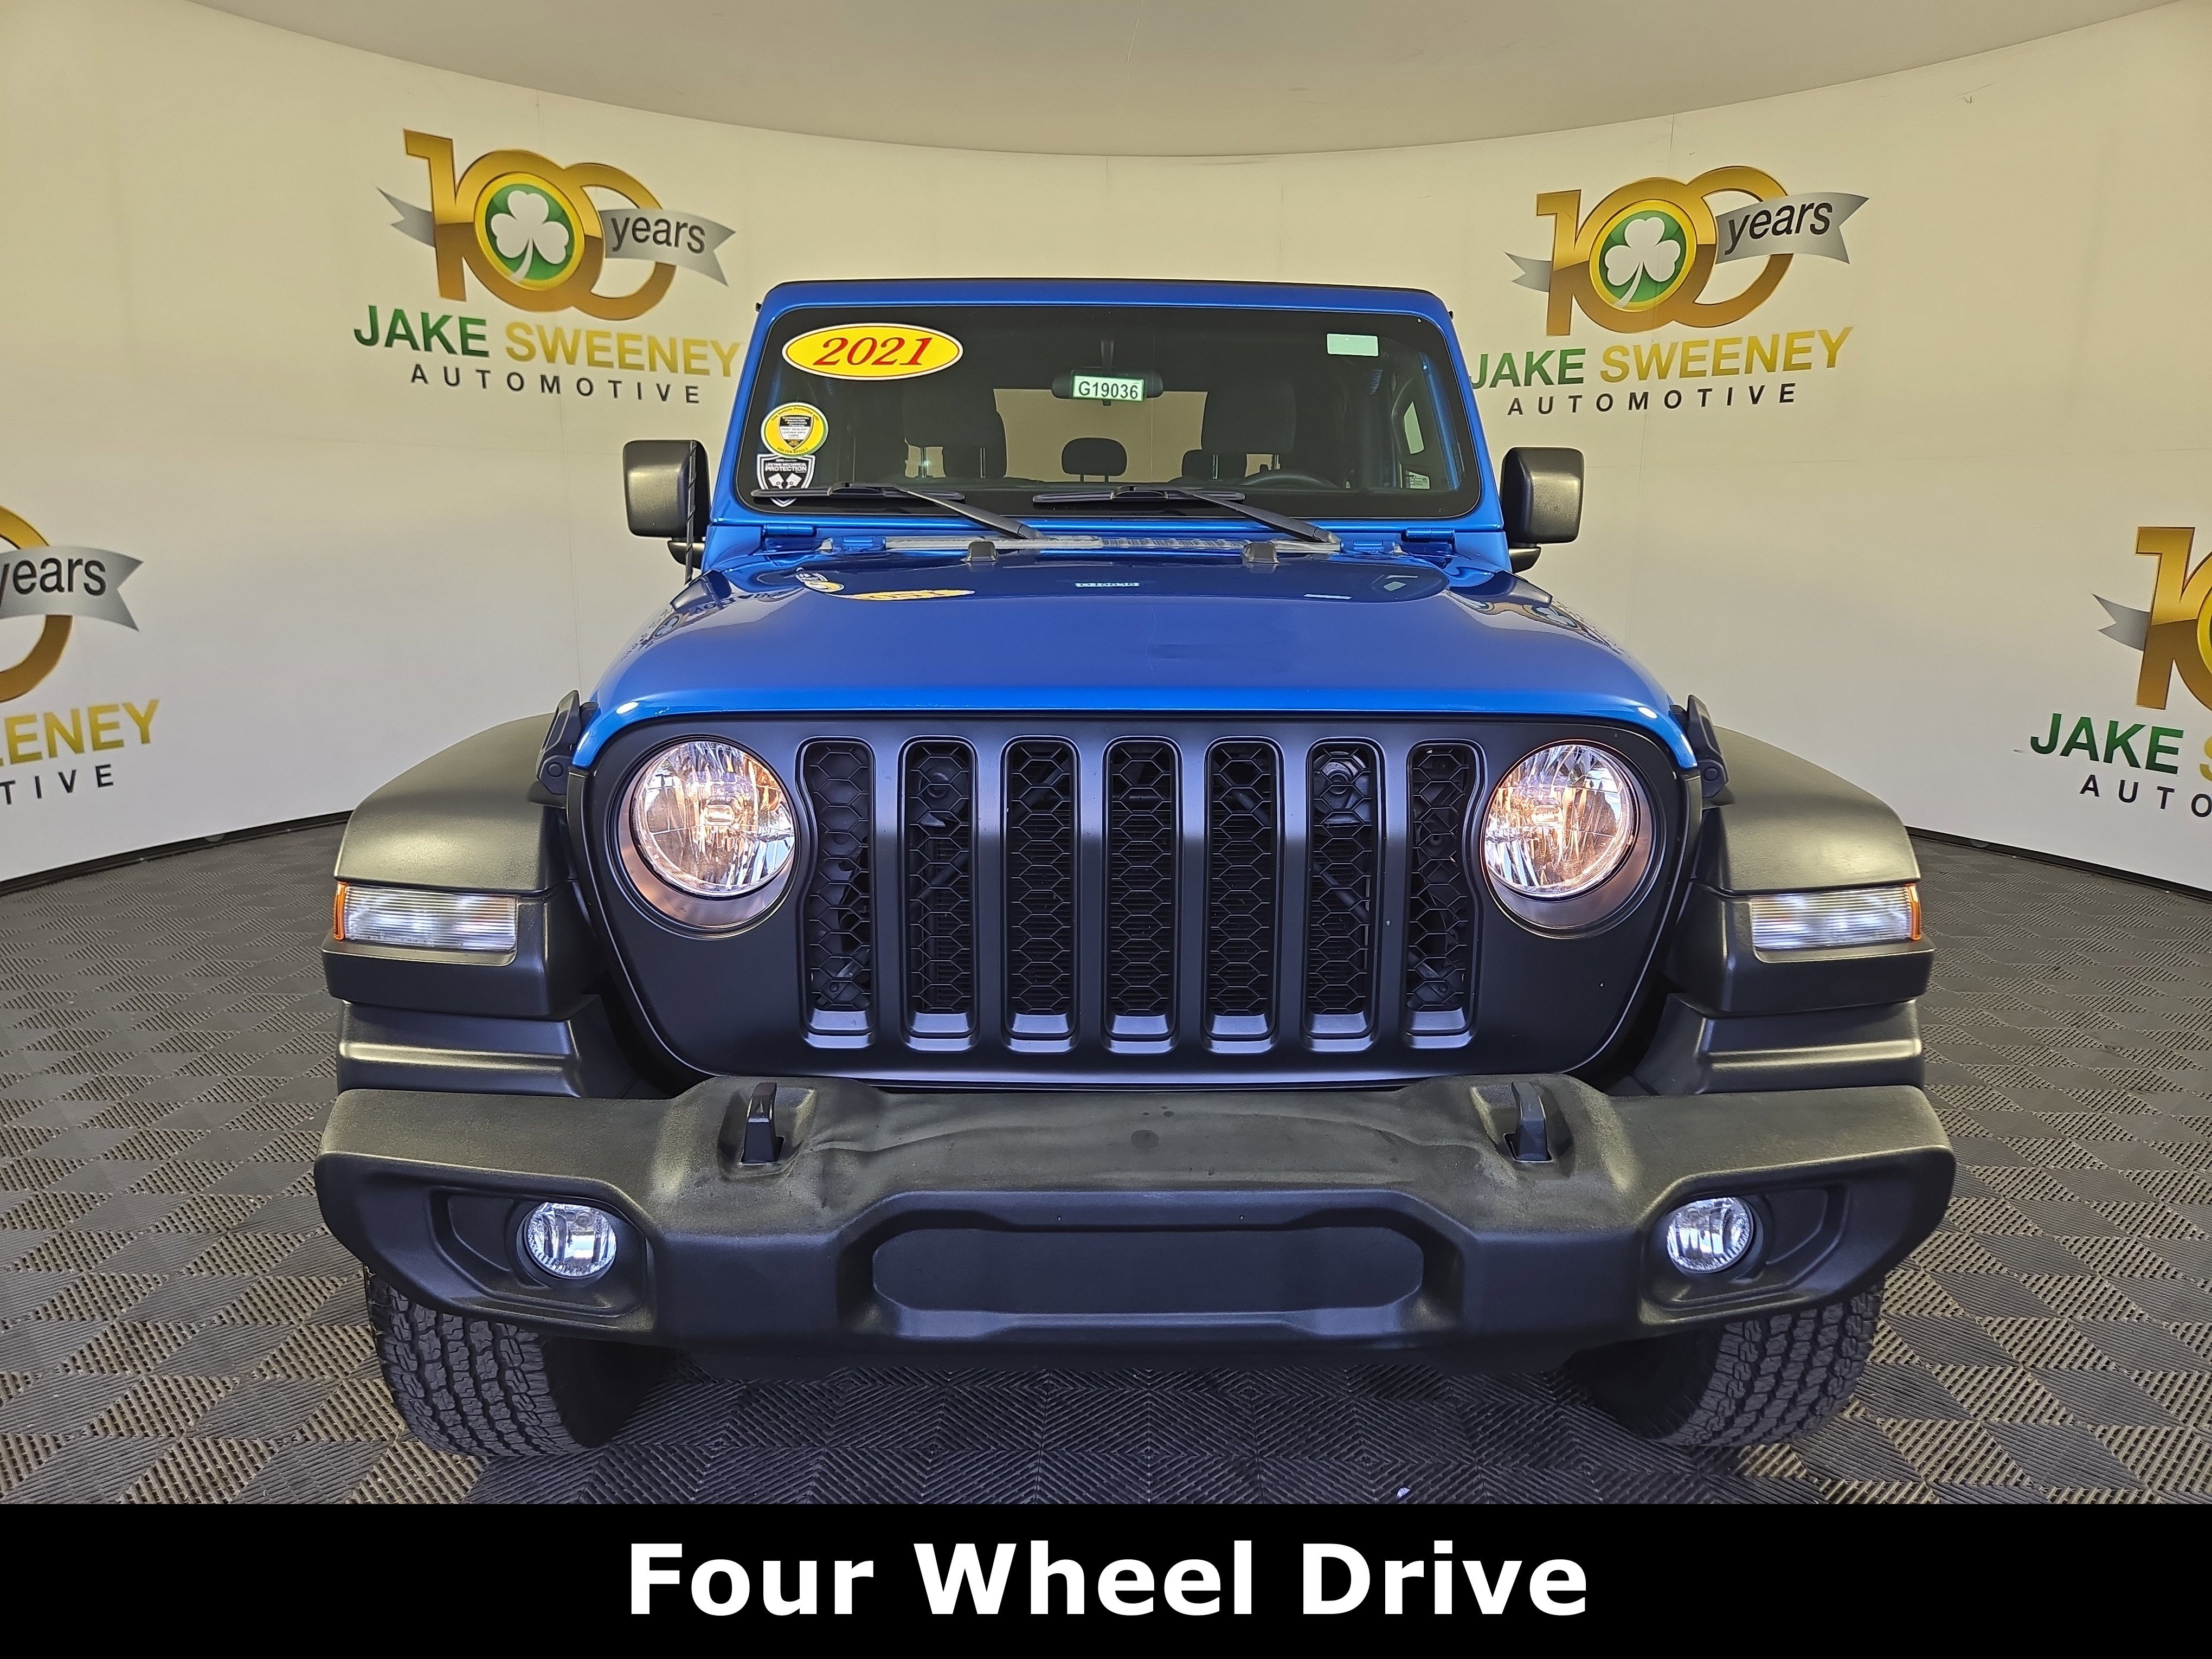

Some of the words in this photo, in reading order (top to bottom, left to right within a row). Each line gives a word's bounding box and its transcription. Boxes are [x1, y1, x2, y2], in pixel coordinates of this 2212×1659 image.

[403, 129, 677, 321] 100
[610, 216, 705, 254] years
[1536, 166, 1794, 336] 100
[1724, 201, 1833, 255] years
[354, 305, 490, 358] JAKE
[505, 322, 740, 378] SWEENEY
[813, 337, 933, 366] 2021
[1470, 348, 1586, 390] JAKE
[1600, 326, 1853, 383] SWEENEY
[411, 364, 700, 404] AUTOMOTIVE
[1078, 381, 1138, 400] G19036
[1507, 383, 1796, 415] AUTOMOTIVE
[0, 698, 160, 766] ENEY
[2030, 713, 2184, 774] JAKE
[2079, 774, 2212, 818] AUTO
